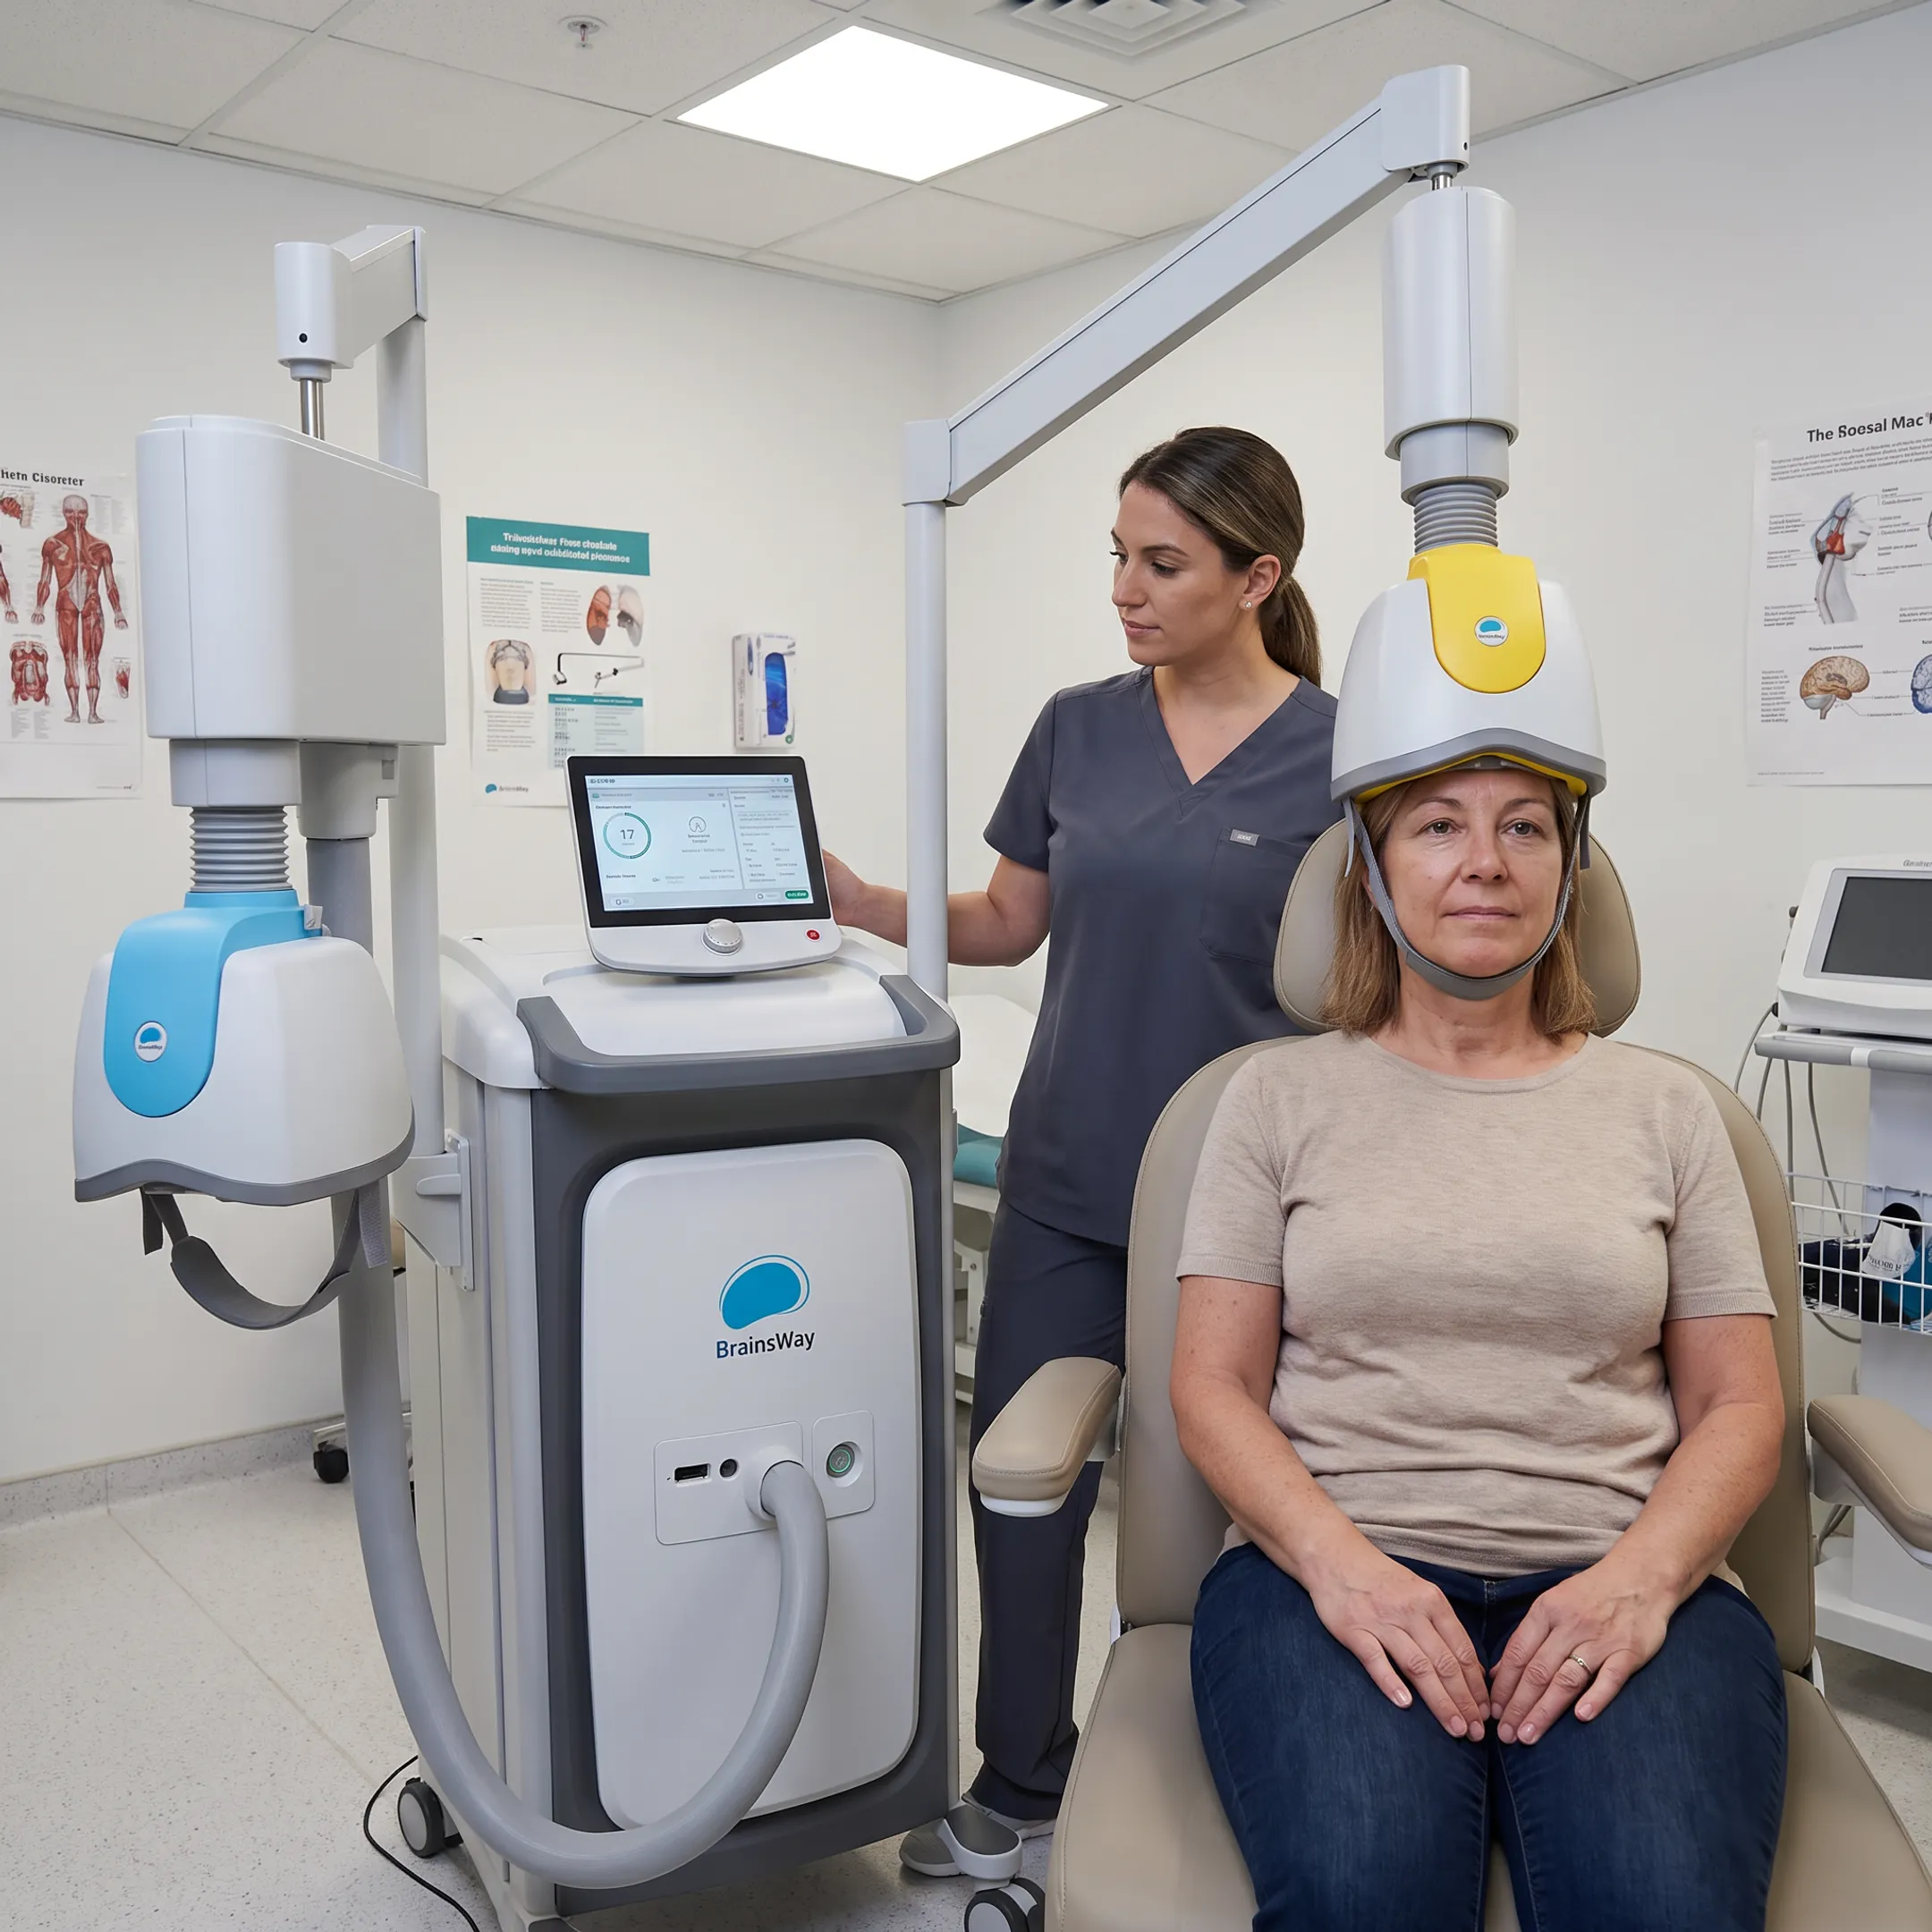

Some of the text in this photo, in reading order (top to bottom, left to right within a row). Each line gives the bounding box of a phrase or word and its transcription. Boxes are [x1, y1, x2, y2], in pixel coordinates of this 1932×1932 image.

[1807, 428, 1834, 443] The
[1891, 416, 1924, 430] Mac
[620, 829, 634, 840] 17
[716, 1331, 815, 1359] BrainsWay
